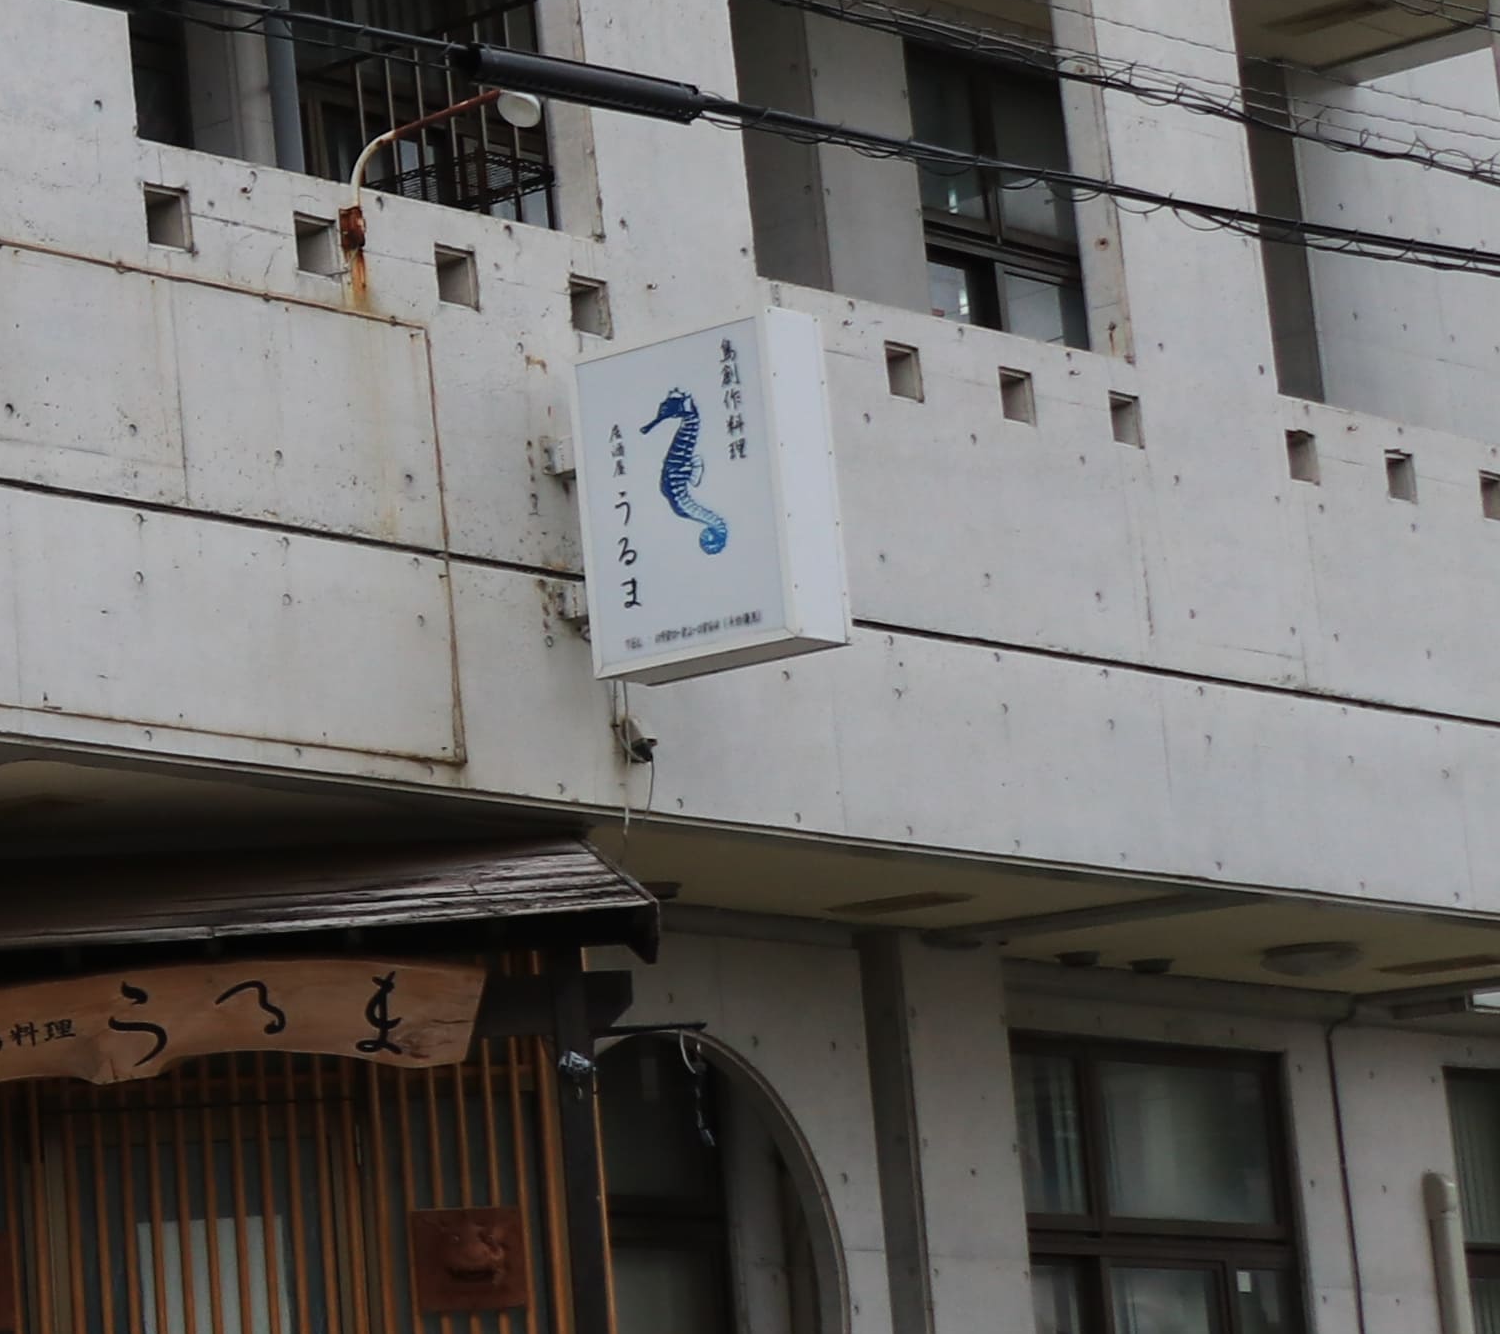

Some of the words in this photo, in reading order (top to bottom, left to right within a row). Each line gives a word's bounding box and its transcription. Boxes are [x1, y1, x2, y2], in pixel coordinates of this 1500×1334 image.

[614, 491, 642, 610] うるま
[107, 970, 403, 1067] うるま
